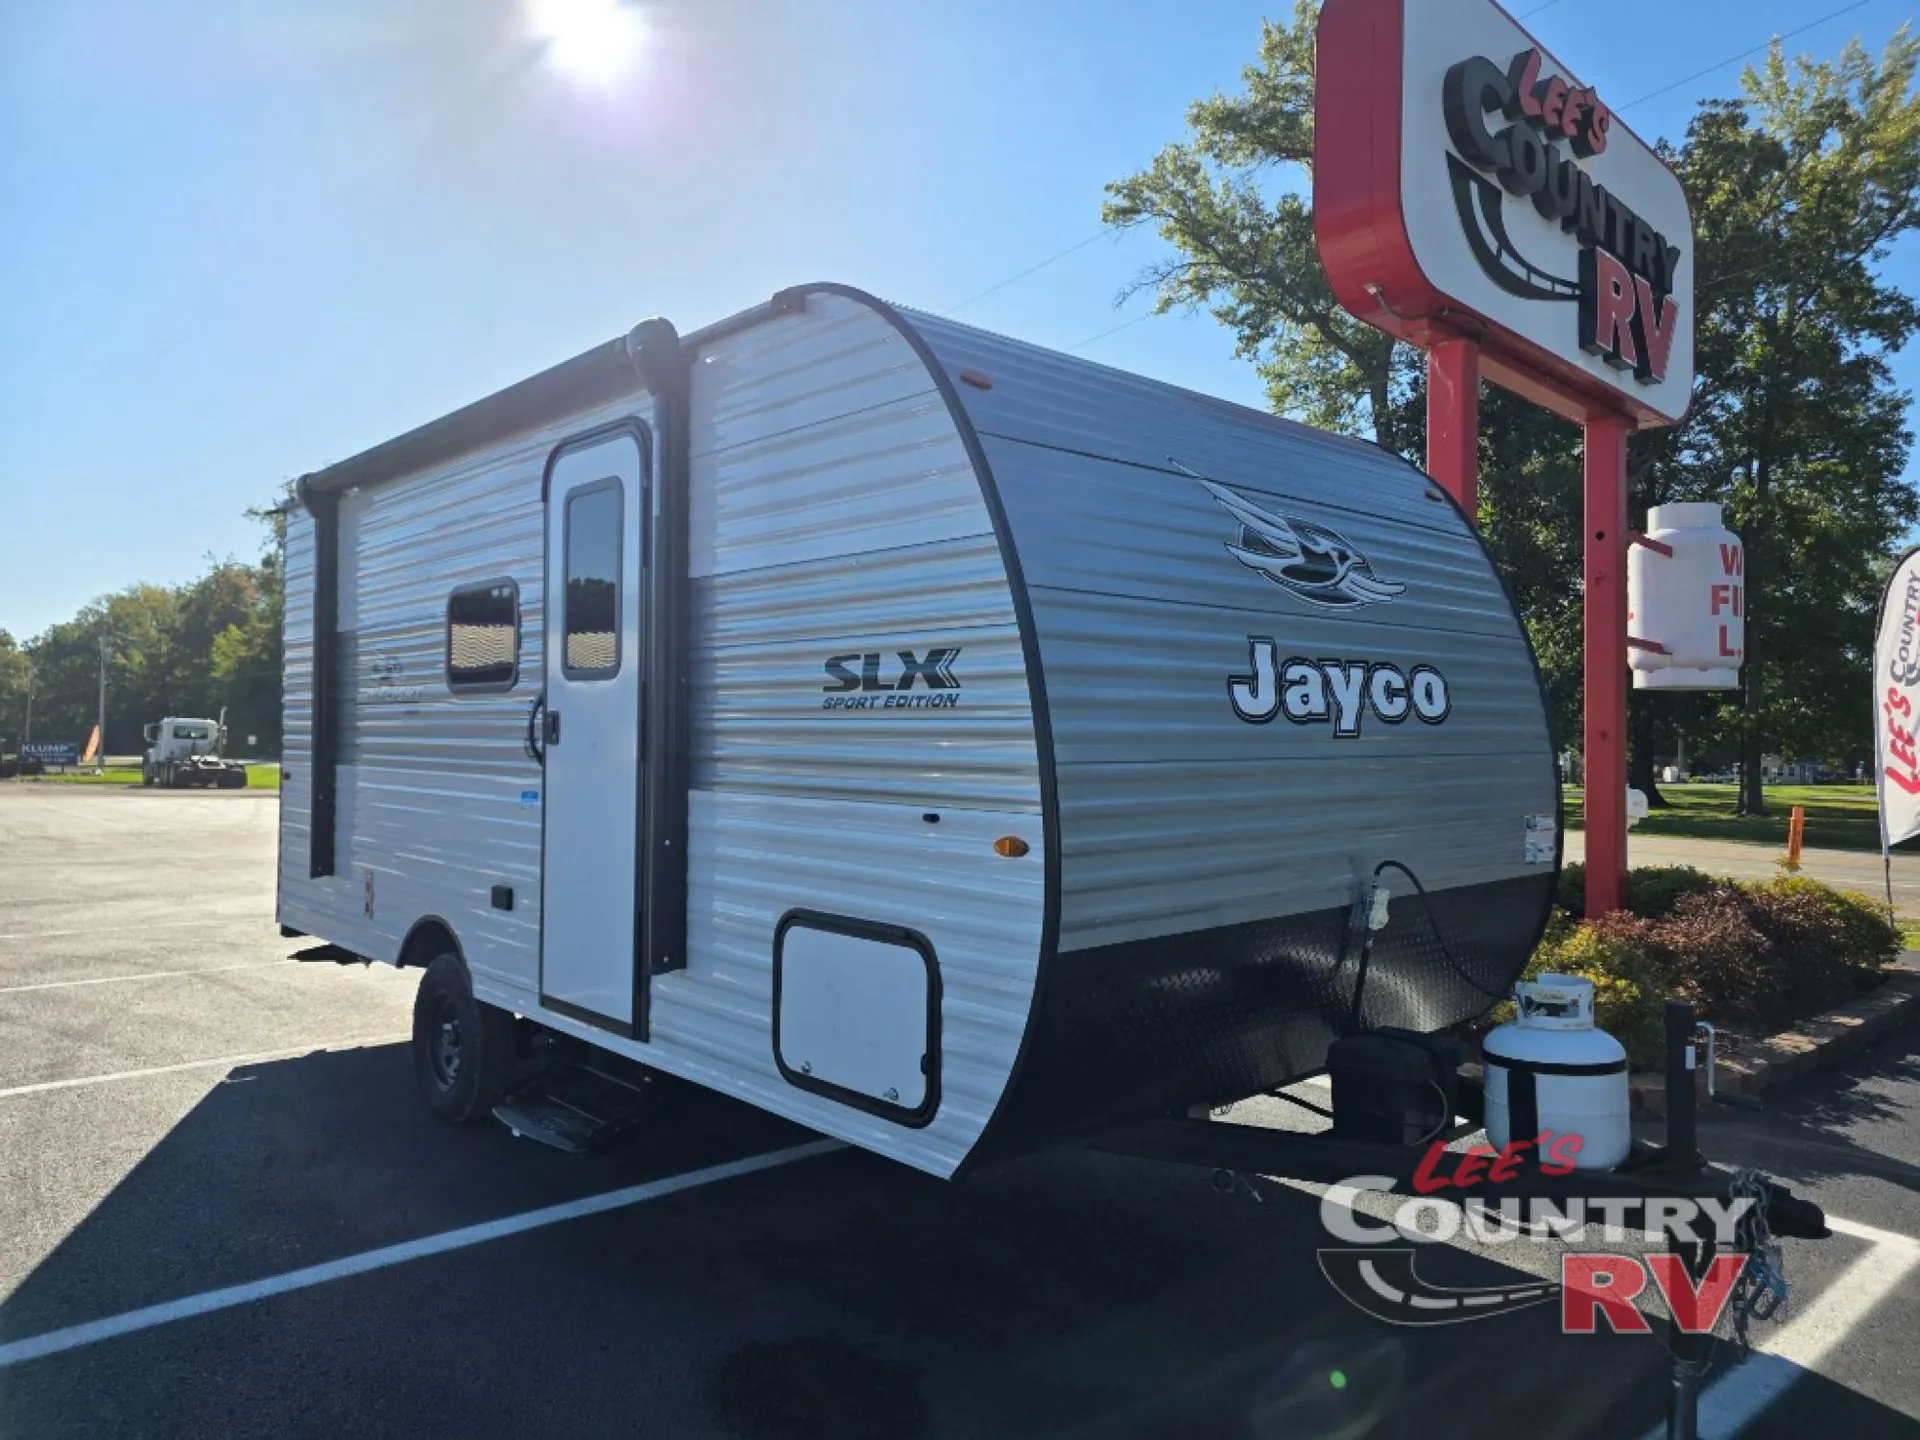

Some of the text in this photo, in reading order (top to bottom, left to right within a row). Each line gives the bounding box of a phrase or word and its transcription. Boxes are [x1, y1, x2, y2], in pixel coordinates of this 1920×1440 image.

[1507, 47, 1610, 158] LEE'S
[1443, 55, 1681, 294] COUNTRY
[1580, 247, 1680, 386] RV
[823, 648, 962, 692] SLX
[823, 692, 961, 710] SPORT EDITION
[1227, 635, 1451, 739] Jayco
